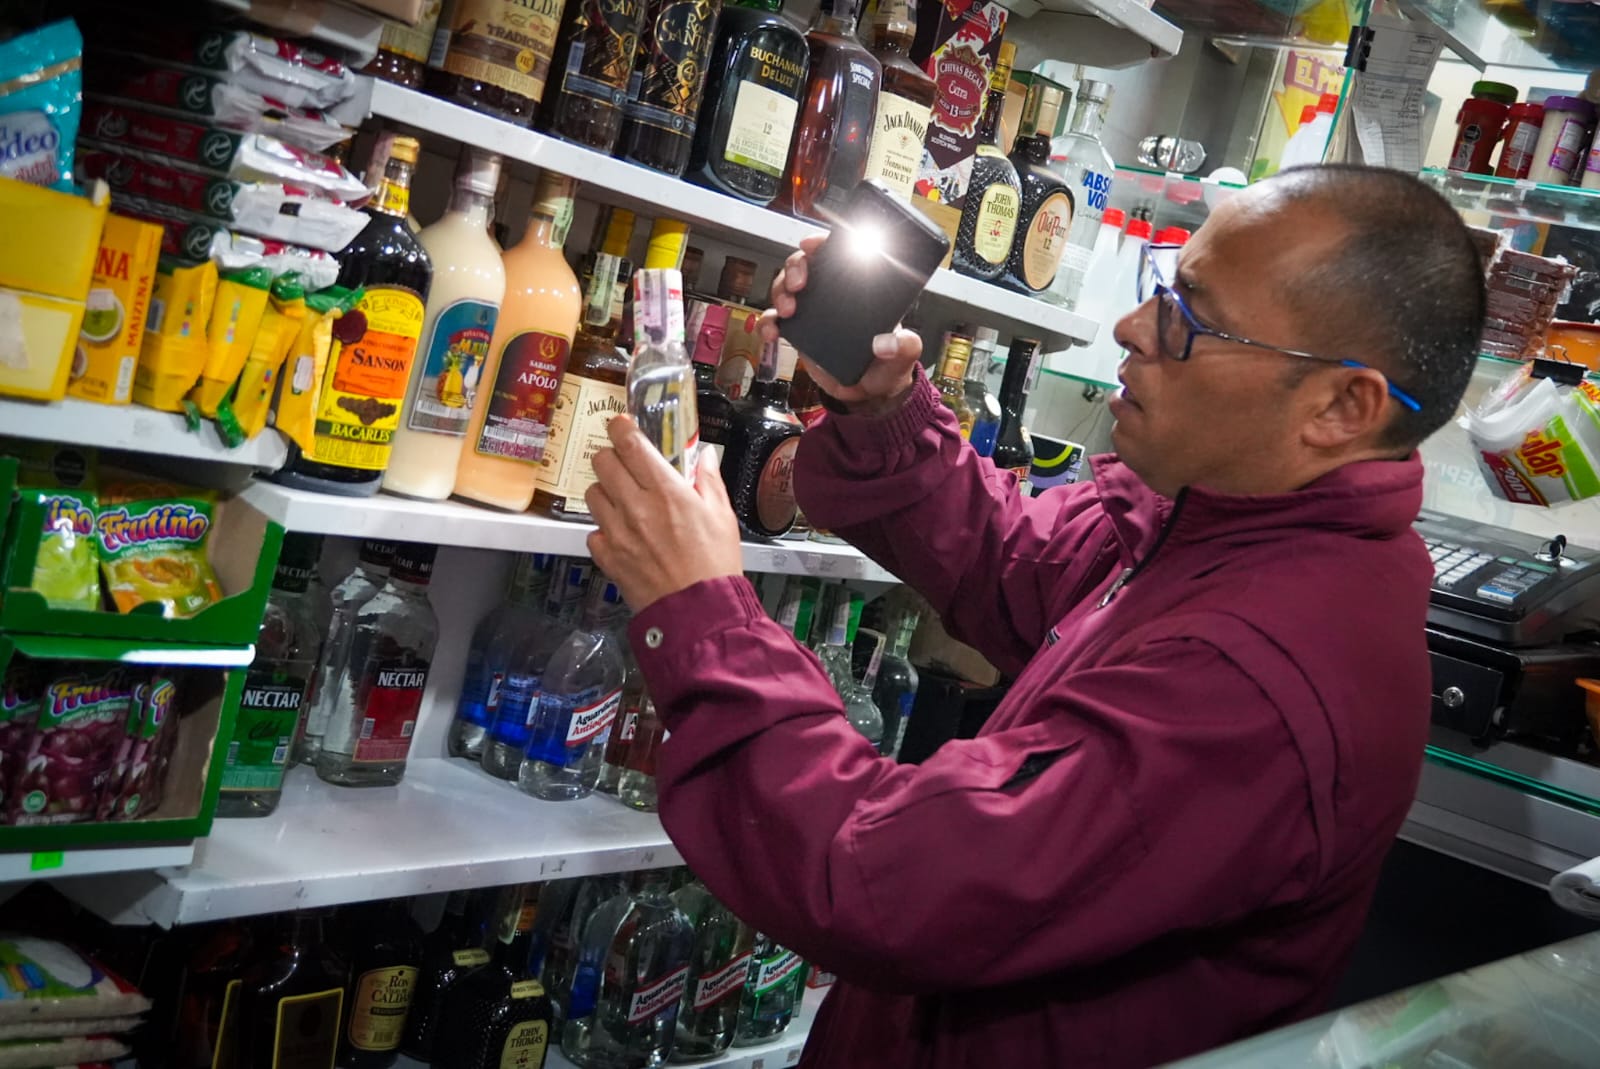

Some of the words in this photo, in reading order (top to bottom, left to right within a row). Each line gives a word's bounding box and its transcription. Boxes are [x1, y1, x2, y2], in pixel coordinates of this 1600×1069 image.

[939, 62, 963, 76] CHIVAS
[963, 68, 983, 90] REGAL
[949, 104, 959, 118] 13
[883, 114, 904, 132] JACK
[881, 168, 912, 184] HONEY
[993, 192, 1014, 206] JOHN
[986, 201, 1016, 219] THOMAS
[517, 371, 558, 391] APOLO
[330, 421, 392, 444] BACARLES
[98, 506, 208, 552] Frutiño
[377, 671, 425, 687] NECTAR
[243, 689, 301, 709] NECTAR
[519, 1026, 541, 1038] JOHN
[511, 1036, 544, 1049] THOMAS
